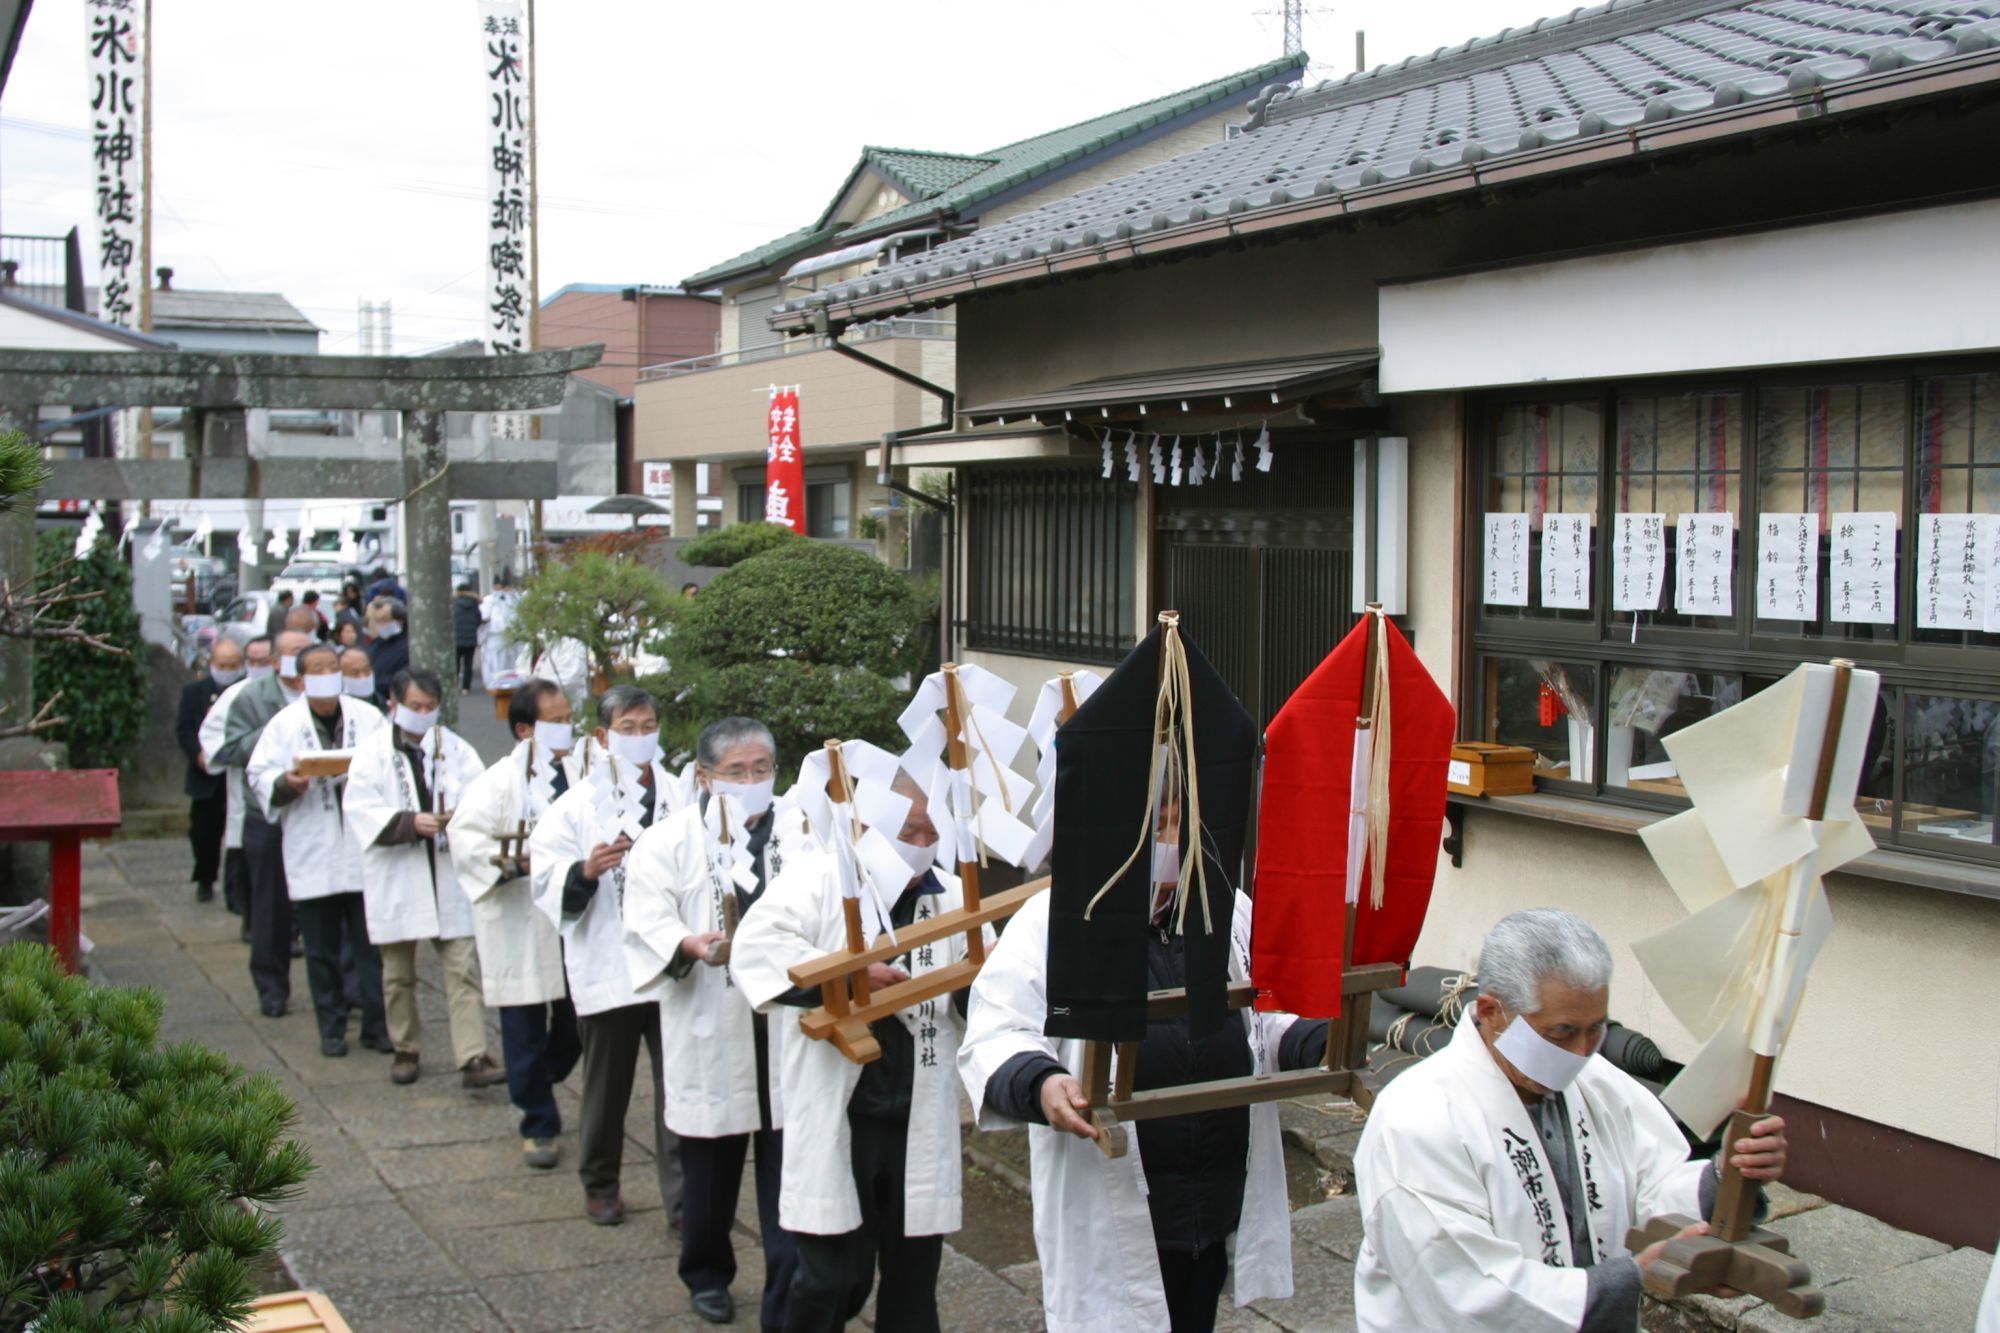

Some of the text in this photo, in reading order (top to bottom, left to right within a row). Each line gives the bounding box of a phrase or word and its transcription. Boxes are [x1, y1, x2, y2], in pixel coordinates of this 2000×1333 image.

[1512, 519, 1521, 564] おみくじ
[1685, 518, 1697, 573] 身代御守
[1712, 524, 1724, 564] 御守
[1795, 515, 1809, 587] 交通安全御守
[1840, 523, 1856, 568] 絵馬
[1870, 524, 1883, 572] こよみ
[918, 999, 938, 1068] 川神社
